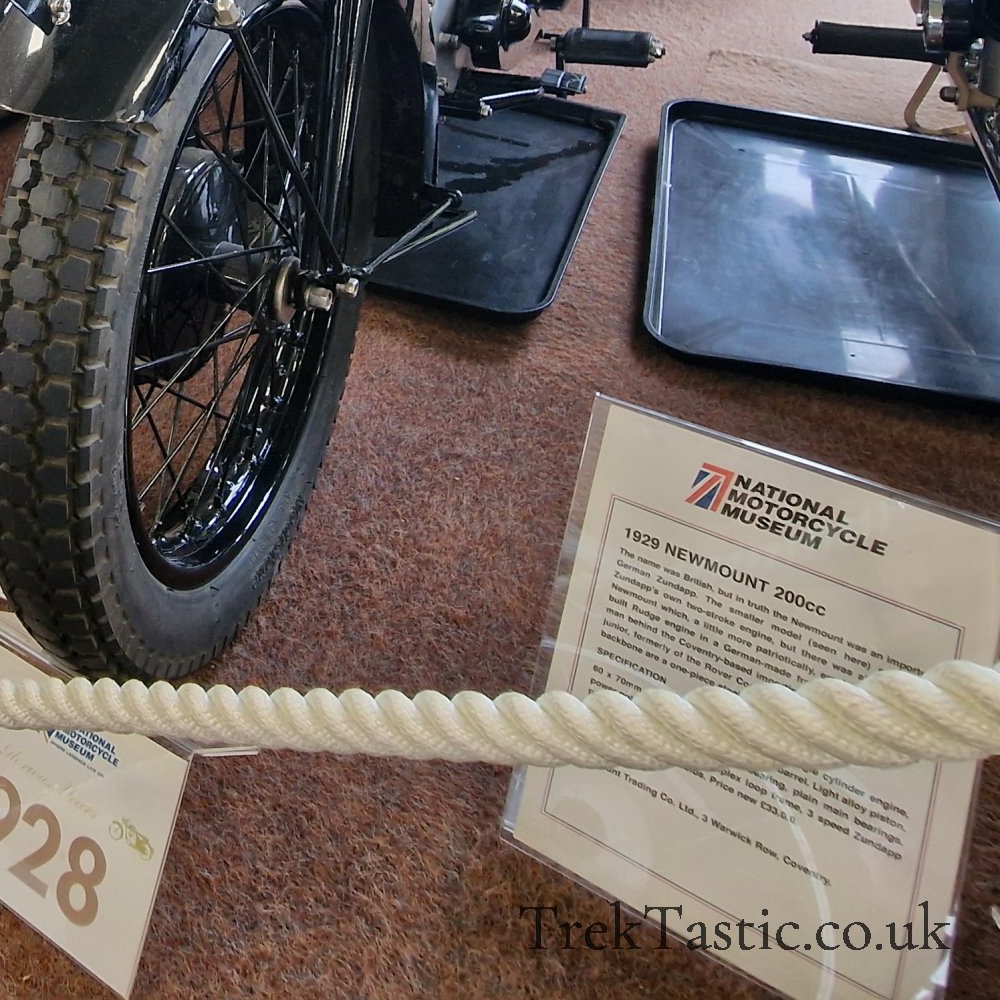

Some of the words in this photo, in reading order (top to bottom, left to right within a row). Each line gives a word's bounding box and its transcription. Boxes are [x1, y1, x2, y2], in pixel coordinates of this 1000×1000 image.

[721, 504, 823, 550] MUSEUM
[727, 490, 888, 556] MOTORCYCLE
[734, 475, 849, 526] NATIONAL
[625, 527, 660, 550] 1929
[664, 542, 770, 592] NEWMOUNT
[774, 586, 827, 616] 200cc
[611, 582, 658, 607] Newmount
[661, 603, 690, 622] which,
[703, 621, 724, 636] little
[728, 633, 752, 648] more
[756, 645, 816, 676] patriotically,
[614, 570, 659, 595] Zundapp's
[663, 592, 682, 605] own
[687, 601, 735, 627] two-stroke
[740, 624, 775, 645] engine,
[780, 640, 796, 653] but
[801, 649, 828, 665] there
[832, 662, 853, 676] was
[617, 559, 651, 579] German
[656, 575, 698, 599] Zundapp.
[705, 595, 723, 608] The
[729, 606, 765, 625] smaller
[771, 623, 802, 640] model
[808, 638, 837, 655] (seen
[844, 652, 871, 671] here)
[620, 547, 635, 559] The
[637, 555, 661, 570] name
[663, 566, 681, 578] was
[684, 573, 715, 592] British,
[718, 587, 733, 600] but
[736, 595, 745, 604] in
[747, 600, 770, 614] truth
[773, 610, 788, 622] the
[791, 617, 844, 644] Newmount
[846, 640, 867, 654] was
[870, 650, 884, 660] an
[597, 646, 667, 684] SPECIFICATION
[601, 630, 643, 654] backbone
[645, 651, 660, 661] are
[670, 662, 715, 686] one-piece
[602, 618, 630, 636] junior,
[633, 631, 671, 654] formerly
[674, 650, 684, 658] of
[686, 654, 702, 667] the
[704, 662, 733, 680] Rover
[606, 607, 625, 620] man
[628, 615, 658, 634] behind
[661, 630, 676, 642] the
[679, 637, 753, 676] Coventry-based
[609, 594, 628, 608] built
[632, 603, 661, 622] Rudge
[664, 619, 696, 637] engine
[700, 633, 709, 643] in
[723, 643, 792, 679] German-made
[593, 664, 604, 674] 60
[616, 675, 642, 692] 70mm
[54, 731, 95, 762] MUSEUM
[624, 773, 657, 798] Trading
[702, 814, 709, 823] 3
[711, 818, 752, 846] Warwick
[709, 775, 735, 794] Price
[737, 791, 758, 805] new
[745, 779, 768, 796] loop
[807, 809, 814, 818] 3
[818, 815, 850, 836] speed
[853, 831, 903, 861] Zundapp
[792, 788, 819, 805] plain
[823, 803, 849, 820] main
[812, 782, 840, 801] Light
[842, 797, 868, 815] alloy
[822, 774, 866, 797] cylinder
[869, 795, 909, 819] engine,
